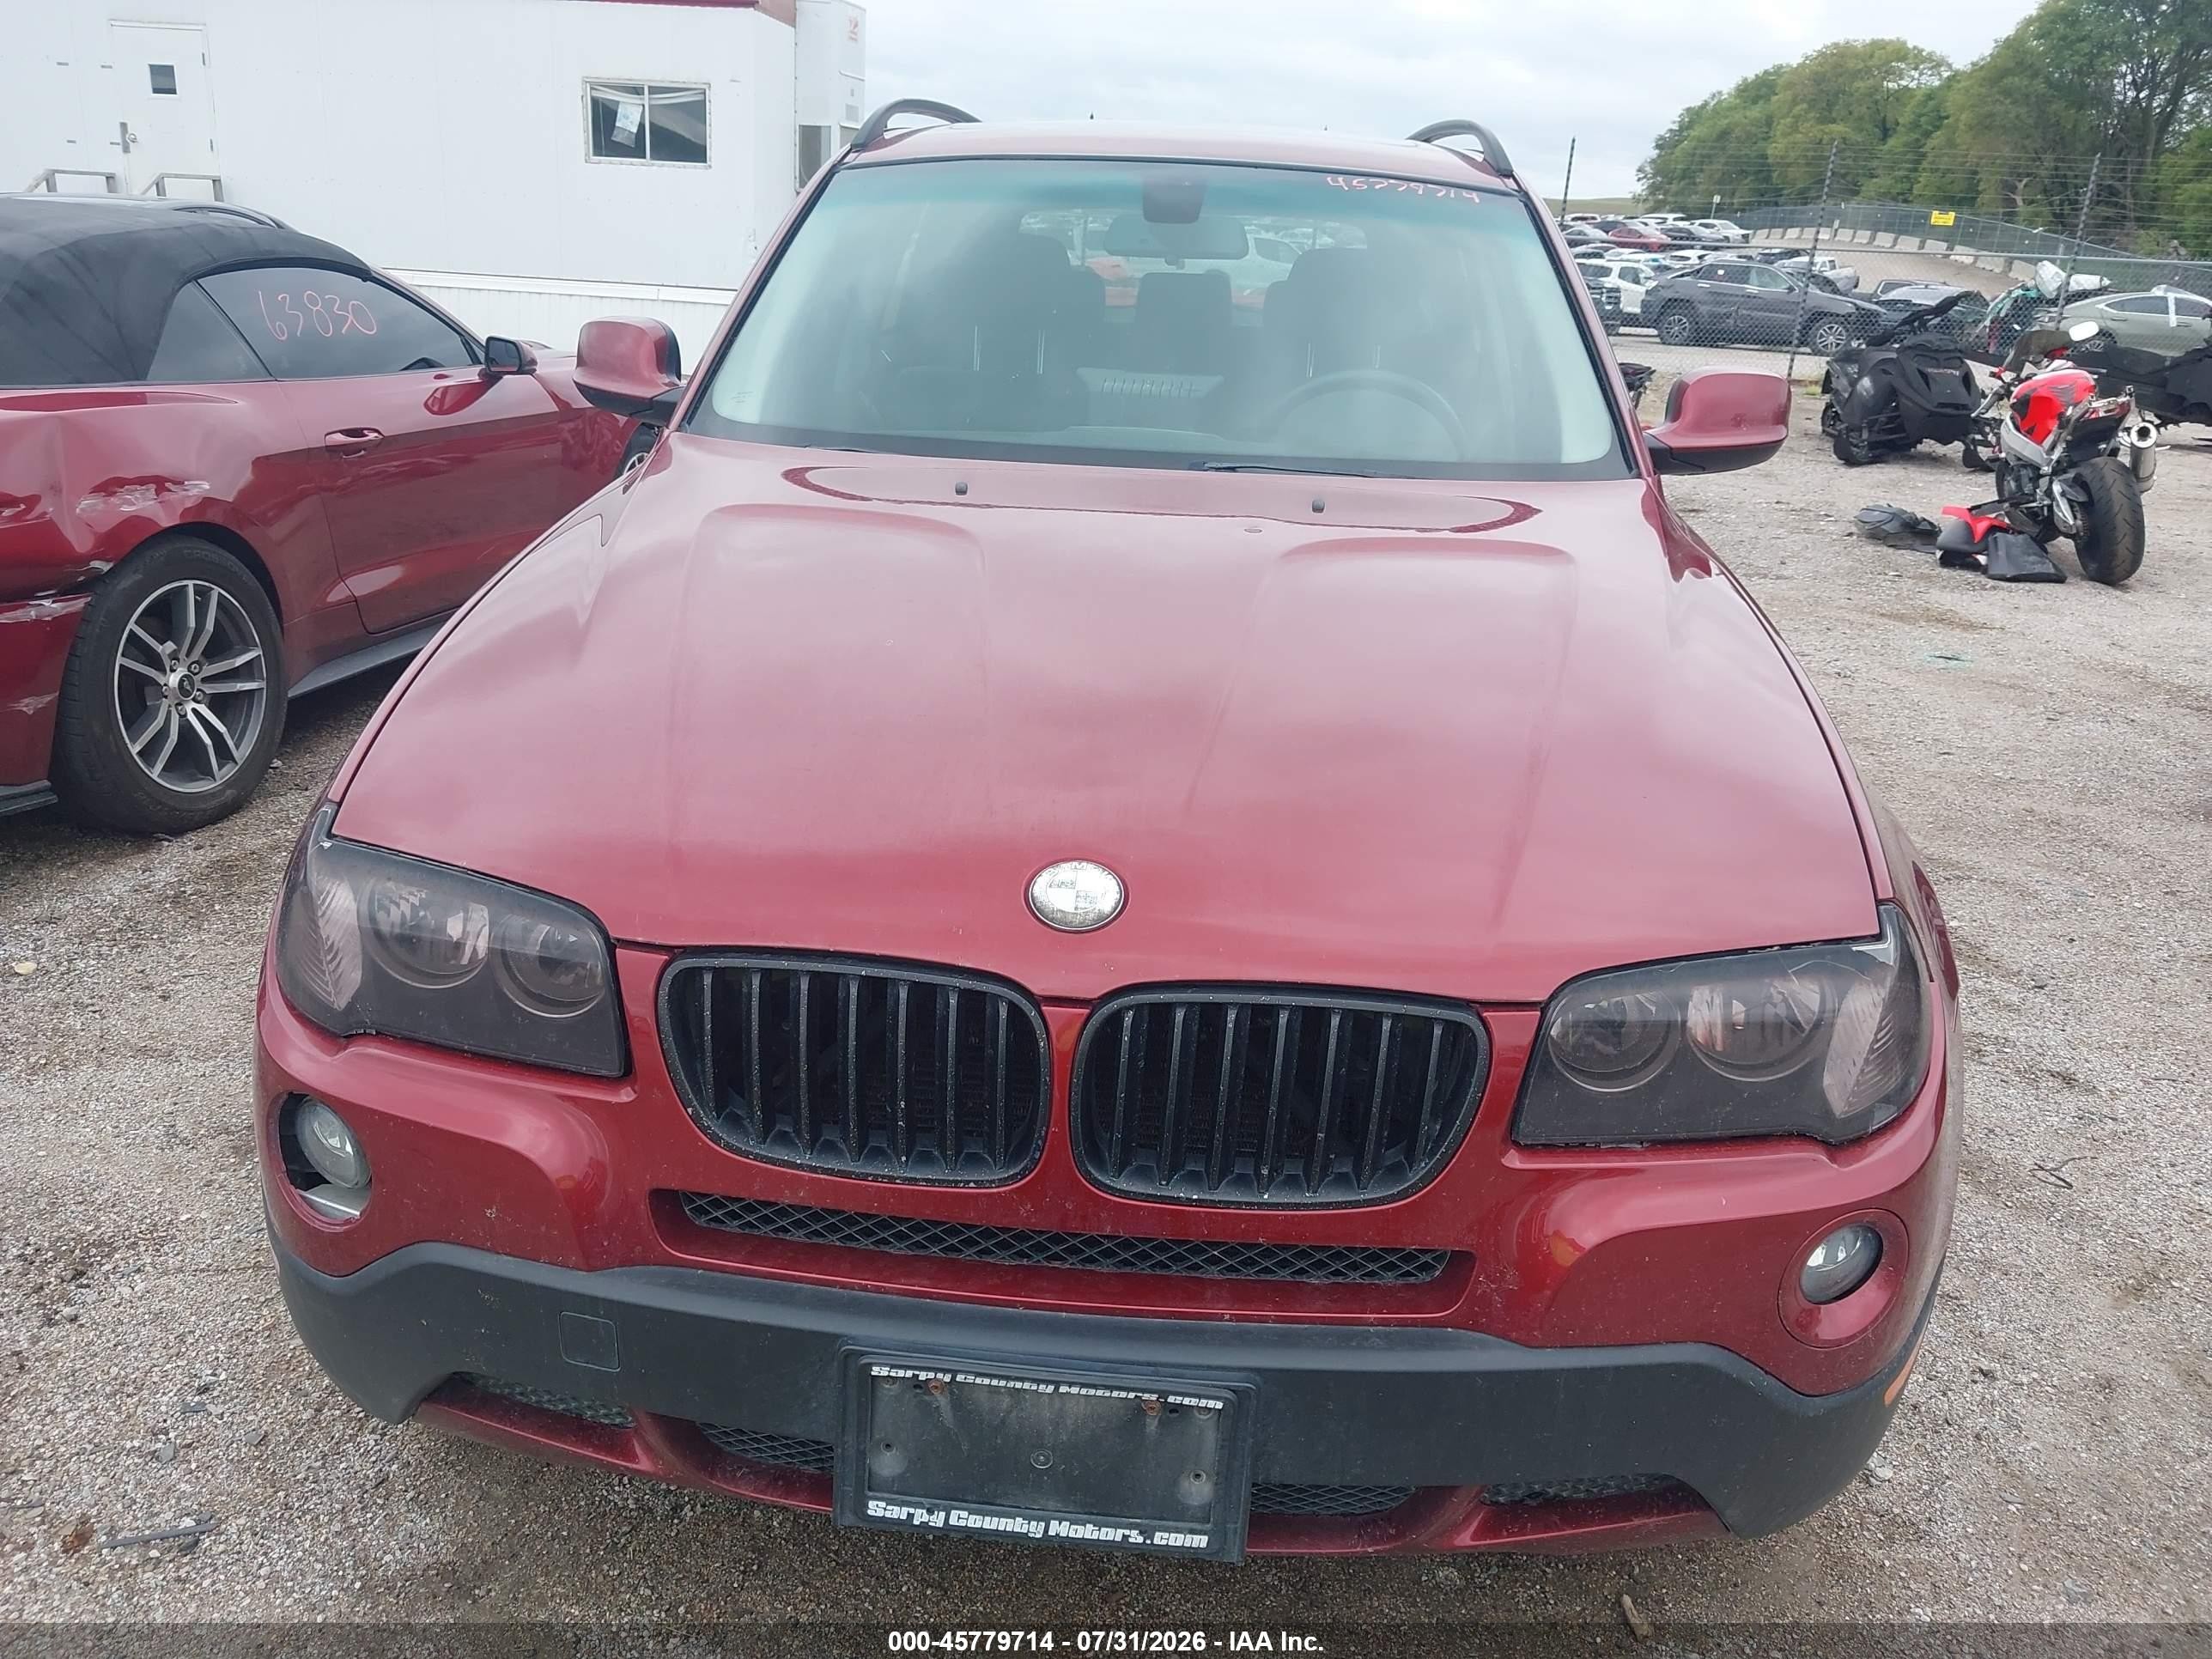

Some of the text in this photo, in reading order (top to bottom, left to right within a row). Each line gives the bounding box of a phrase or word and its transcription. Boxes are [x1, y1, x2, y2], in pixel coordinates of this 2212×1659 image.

[258, 290, 377, 340] 63830
[871, 1366, 1224, 1410] Sarpy County Motors.com
[867, 1500, 1209, 1548] Sarpy County Motors.com
